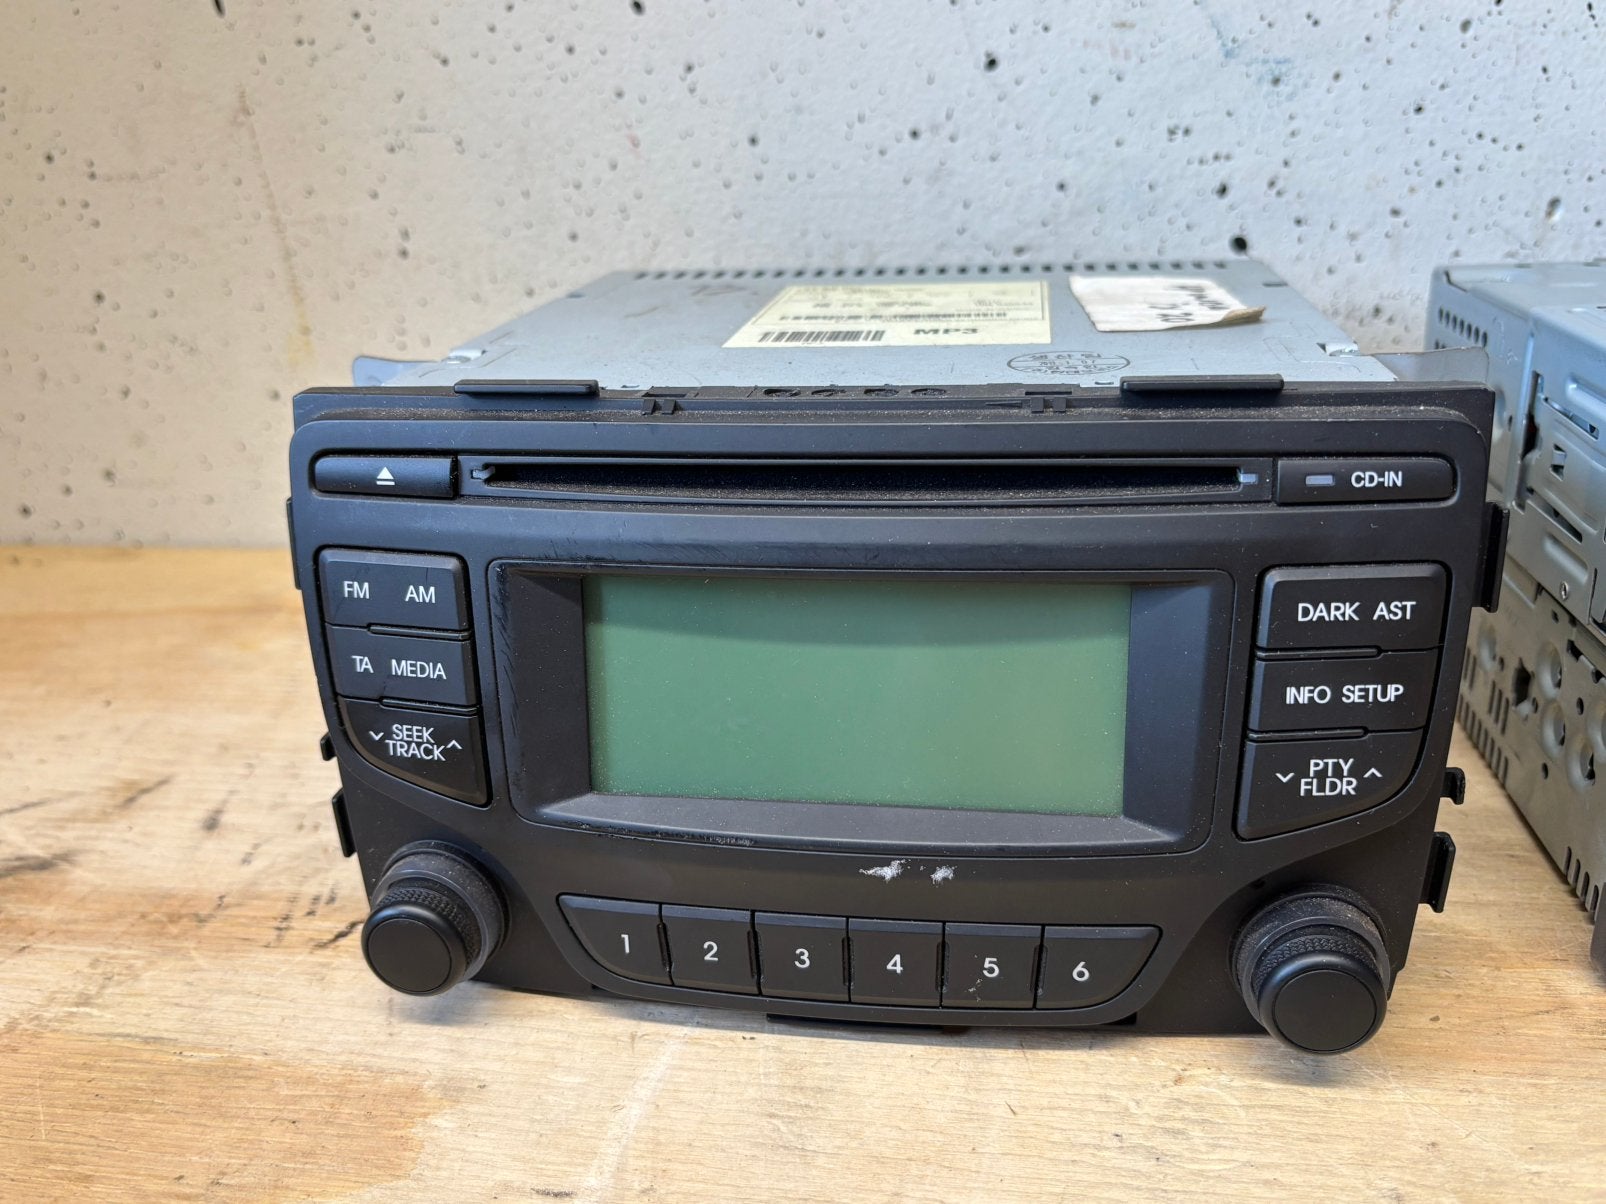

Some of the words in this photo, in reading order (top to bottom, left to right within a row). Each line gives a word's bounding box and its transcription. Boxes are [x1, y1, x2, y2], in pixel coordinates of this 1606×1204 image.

[913, 328, 979, 336] MP3
[1350, 470, 1403, 488] CD-IN
[343, 580, 370, 599] FM
[405, 584, 436, 604] AM
[1297, 601, 1361, 622] DARK
[1372, 601, 1417, 621] AST
[351, 655, 374, 674] TA
[391, 658, 447, 680] MEDIA
[1285, 685, 1332, 705] INFO
[1341, 683, 1404, 704] SETUP
[392, 723, 435, 744] SEEK
[385, 739, 446, 762] TRACK
[1309, 758, 1354, 778] PTY
[1300, 777, 1358, 797] FLDR
[620, 933, 631, 954] 1
[703, 940, 719, 962] 2
[794, 948, 811, 969] 3
[886, 953, 904, 975] 4
[982, 957, 1000, 978] 5
[1072, 961, 1090, 982] 6
